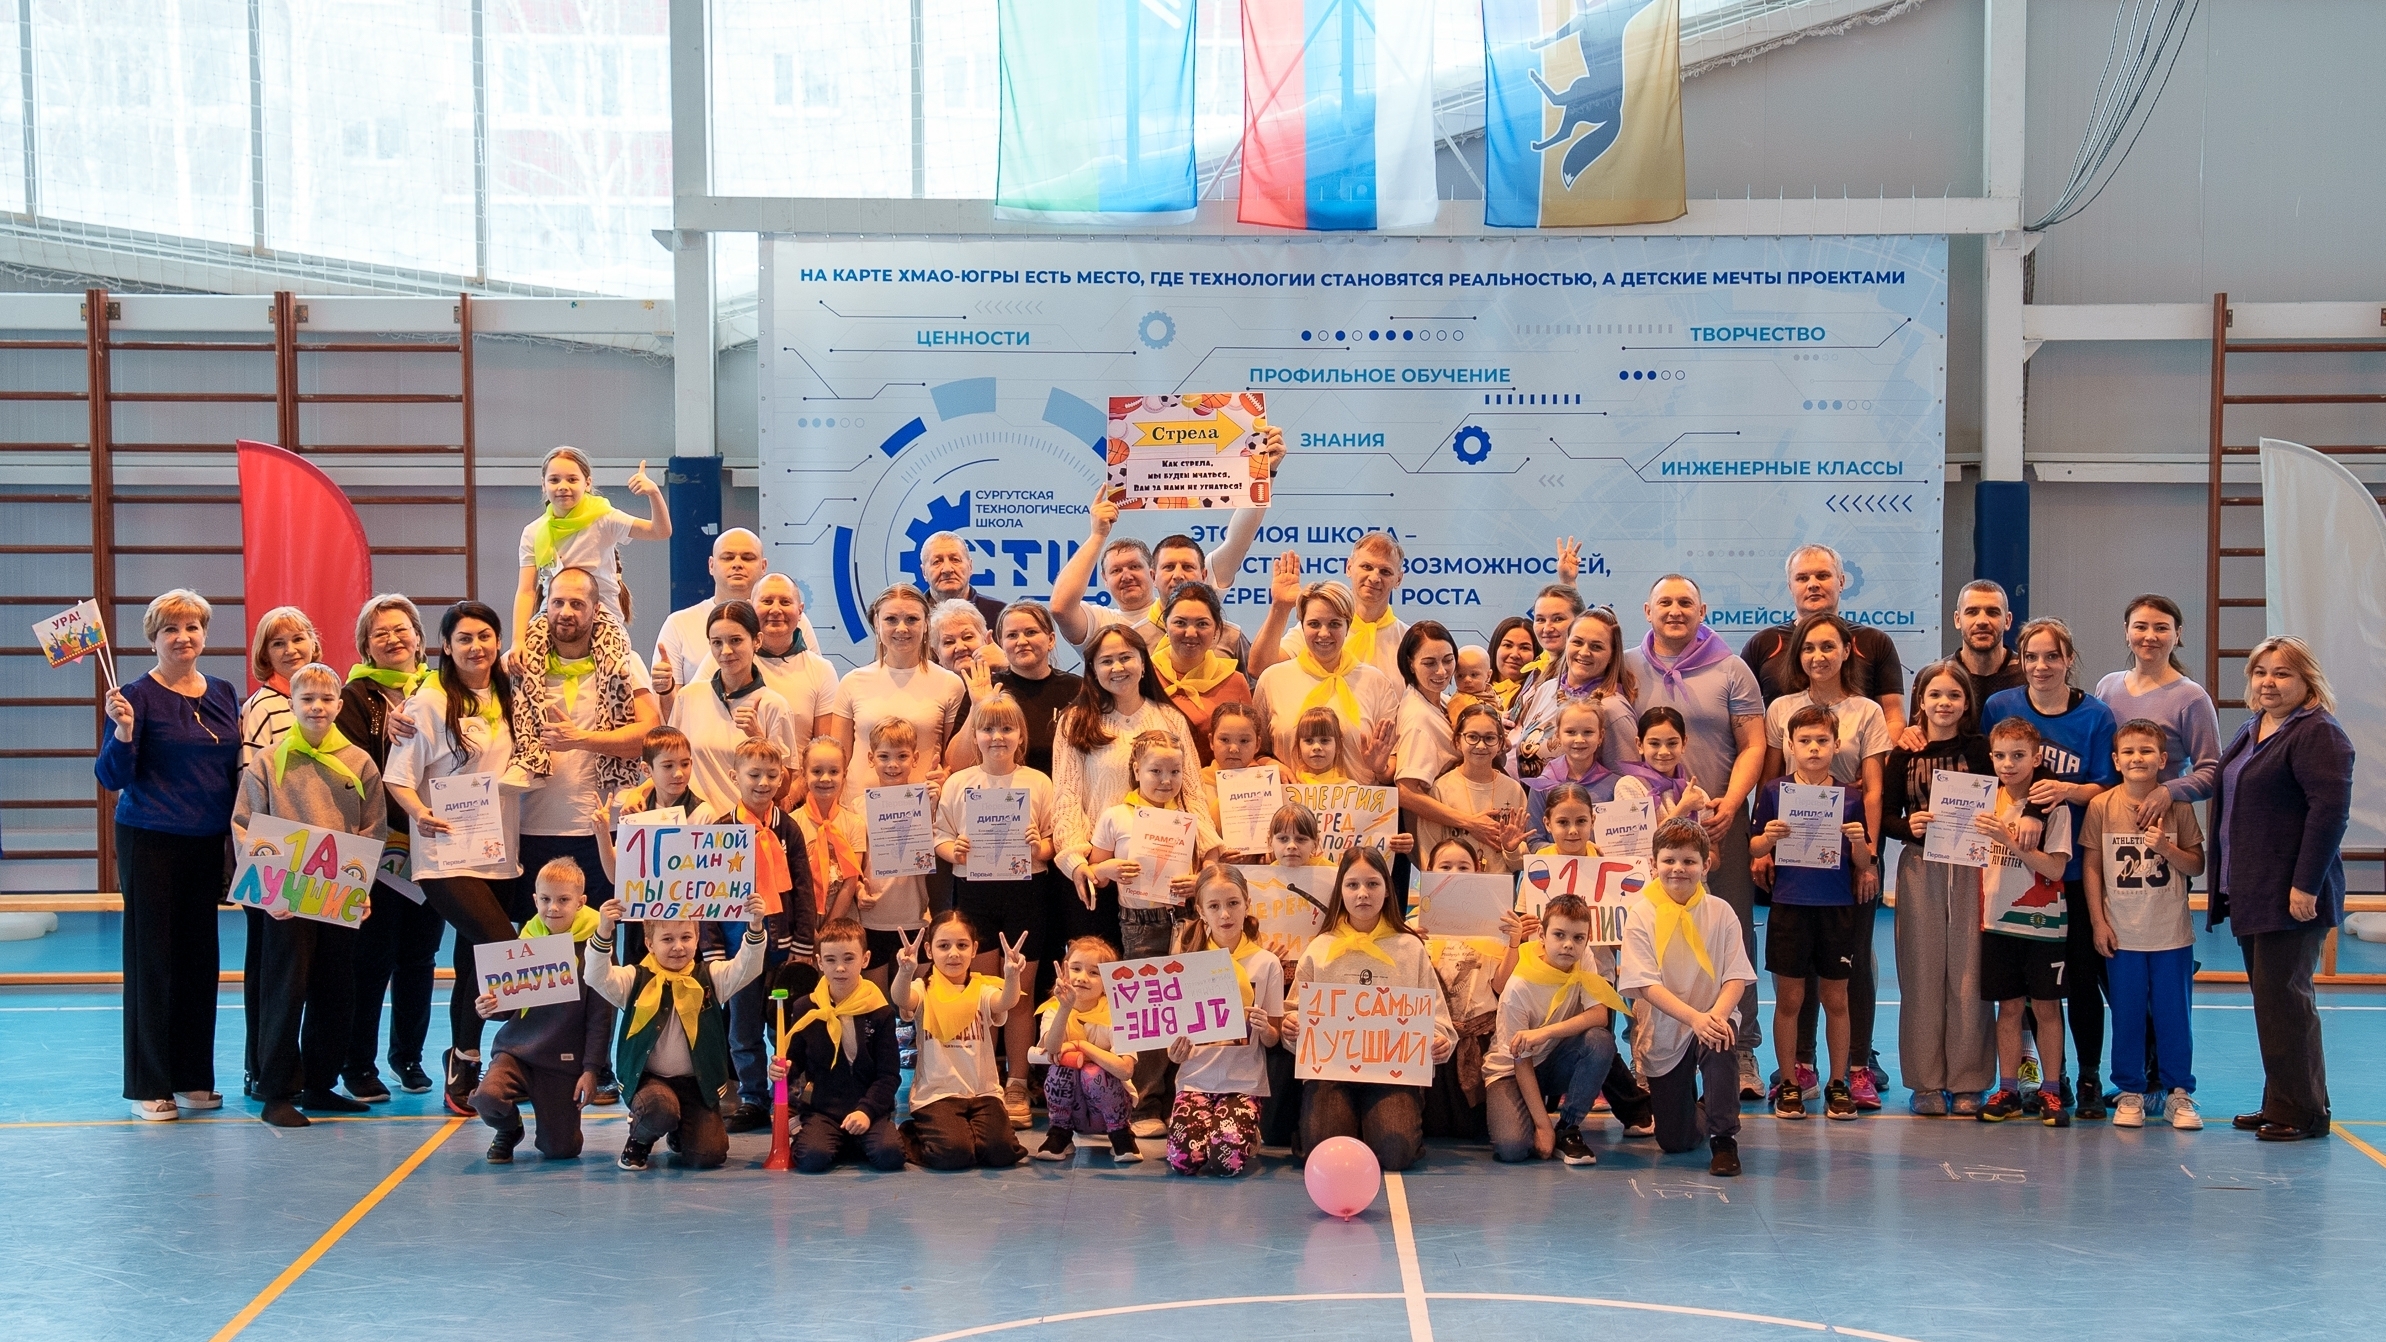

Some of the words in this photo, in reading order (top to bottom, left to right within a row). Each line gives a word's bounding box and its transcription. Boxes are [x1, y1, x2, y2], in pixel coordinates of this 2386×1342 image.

[800, 268, 827, 282] НА
[833, 268, 892, 283] КАРТЕ
[898, 269, 1019, 284] ХМАО-ЮГРЫ
[1025, 270, 1071, 284] ЕСТЬ
[1077, 270, 1145, 287] МЕСТО,
[1150, 271, 1183, 287] ГДЕ
[1189, 272, 1315, 287] ТЕХНОЛОГИИ
[1320, 272, 1444, 287] СТАНОВЯТСЯ
[1449, 272, 1597, 288] РЕАЛЬНОСТЬЮ,
[1602, 272, 1616, 286] А
[1620, 271, 1707, 288] ДЕТСКИЕ
[1713, 271, 1781, 285] МЕЧТЫ
[1787, 271, 1905, 285] ПРОЕКТАМИ
[917, 330, 1030, 347] ЦЕННОСТИ
[1690, 326, 1826, 342] ТВОРЧЕСТВО
[1250, 368, 1396, 384] ПРОФИЛЬНОЕ
[1401, 368, 1511, 383] ОБУЧЕНИЕ
[1152, 426, 1220, 443] Стрела
[1300, 432, 1385, 448] ЗНАНИЯ
[1661, 460, 1811, 476] ИНЖЕНЕРНЫЕ
[1817, 460, 1903, 476] КЛАССЫ
[975, 490, 1054, 500] СУРГУТСКАЯ
[975, 504, 1091, 515] ТЕХНОЛОГИЧЕСКА
[975, 518, 1023, 528] ШКОЛА
[1307, 526, 1399, 543] ШКОА
[1402, 588, 1481, 605] РОСТА
[52, 611, 81, 630] УРА!
[444, 798, 489, 812] ДИПЛОМ
[1285, 785, 1387, 813] ЭНЕРГИЯ
[1941, 797, 1986, 809] ДИПЛОМ
[878, 809, 922, 822] ДИПЛОМ
[977, 814, 1021, 824] ДИПЛОМ
[1789, 809, 1833, 818] ДИПЛОМ
[1605, 823, 1648, 836] ДИПЛОМ
[284, 828, 338, 879] 1А
[626, 828, 681, 878] 1Г
[690, 828, 749, 850] ТАКОЙ
[2115, 845, 2171, 888] 23
[625, 879, 664, 903] МЫ
[669, 880, 752, 901] СЕГОДНЯ
[1125, 887, 1149, 897] Первые
[630, 902, 743, 920] ПОБЕДИМ
[2050, 961, 2065, 985] 7
[1307, 989, 1346, 1017] 1Г
[1354, 991, 1432, 1017] САМЫЙ
[1187, 998, 1230, 1034] 1Г
[1299, 1027, 1427, 1066] ЛУЧШИЙ
